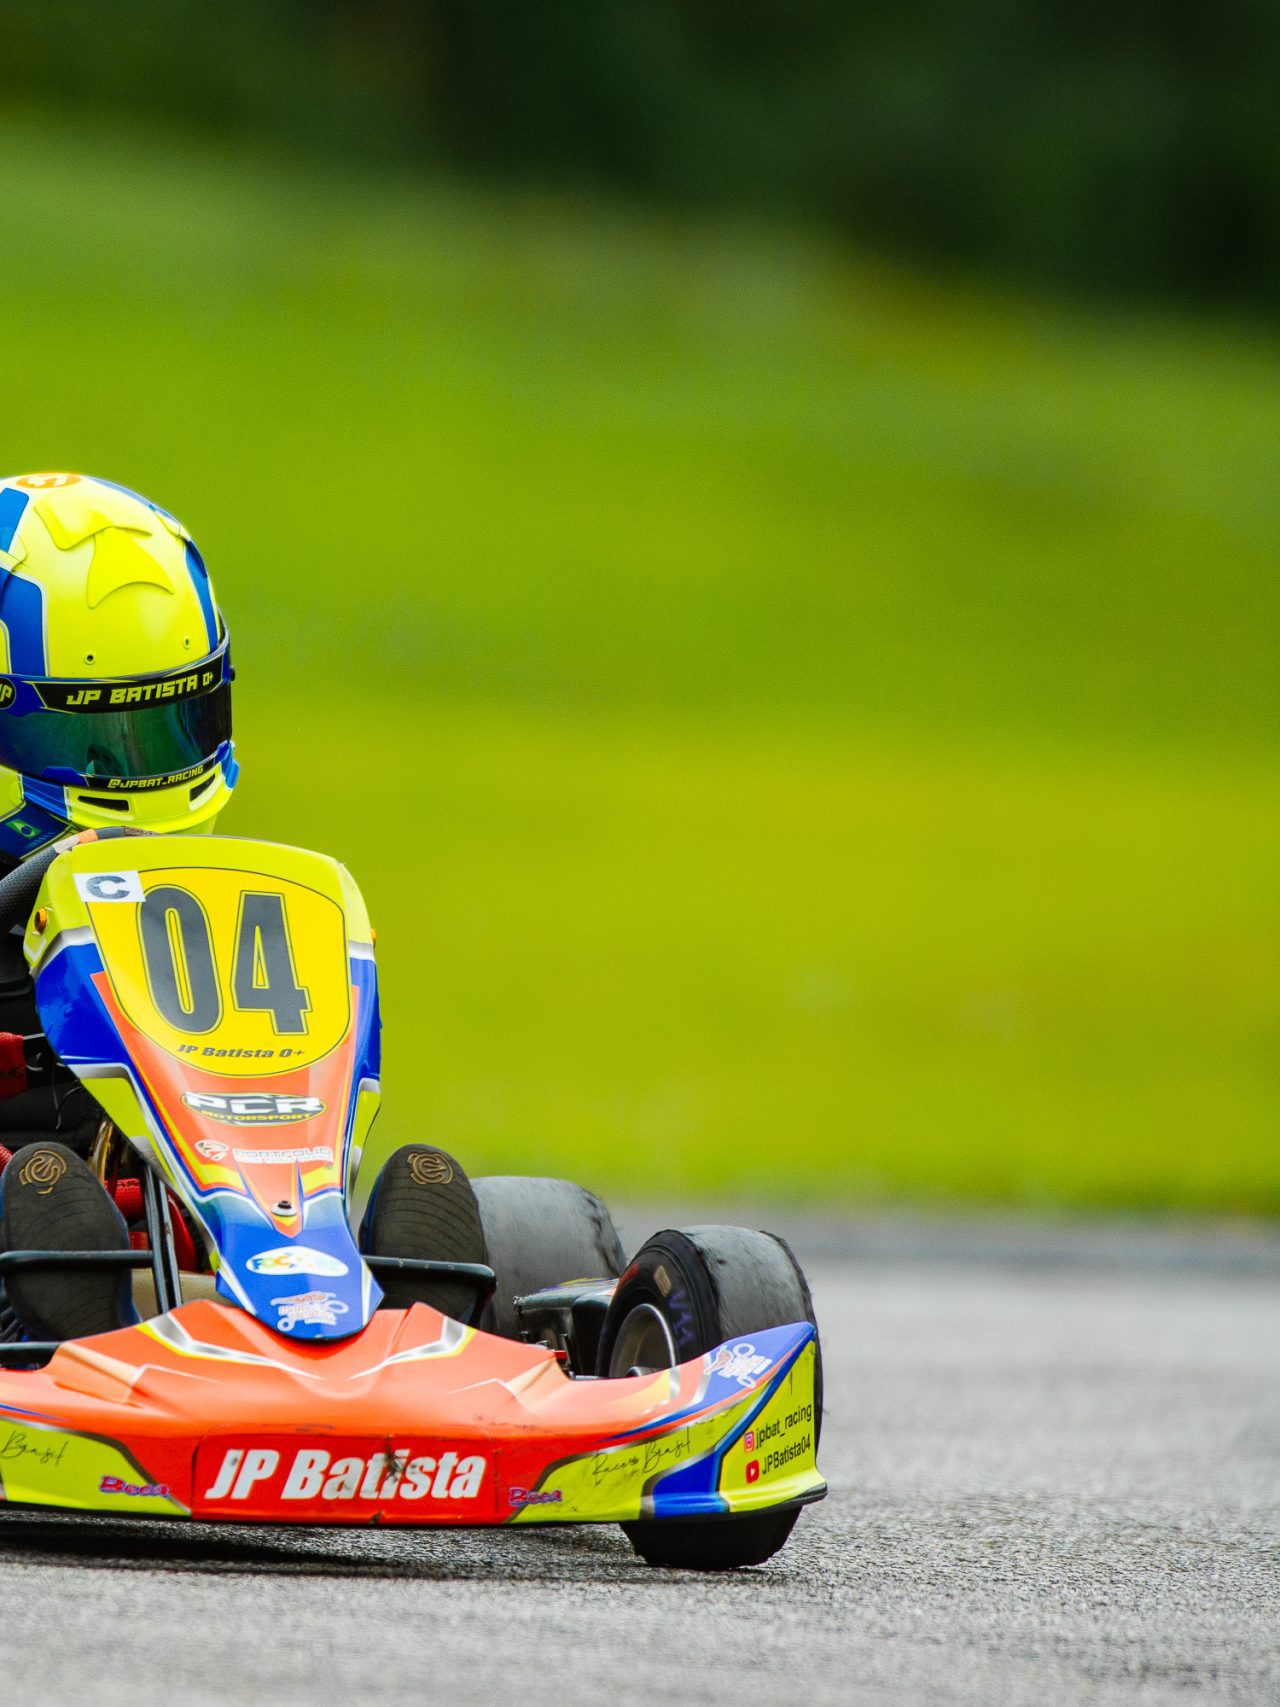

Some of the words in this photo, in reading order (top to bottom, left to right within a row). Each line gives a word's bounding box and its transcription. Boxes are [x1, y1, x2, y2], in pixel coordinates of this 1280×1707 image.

[66, 690, 101, 706] JP
[109, 675, 198, 704] BATISTA
[86, 875, 131, 900] C
[136, 884, 313, 1036] 04
[177, 1044, 198, 1054] JP
[201, 1047, 274, 1058] Batista
[184, 1091, 323, 1114] PCR
[200, 1110, 312, 1122] MOTORSPORT
[755, 1403, 812, 1450] jpbat_racing
[761, 1433, 811, 1475] JPBatista04
[204, 1449, 279, 1499] JP
[280, 1449, 486, 1500] Batista
